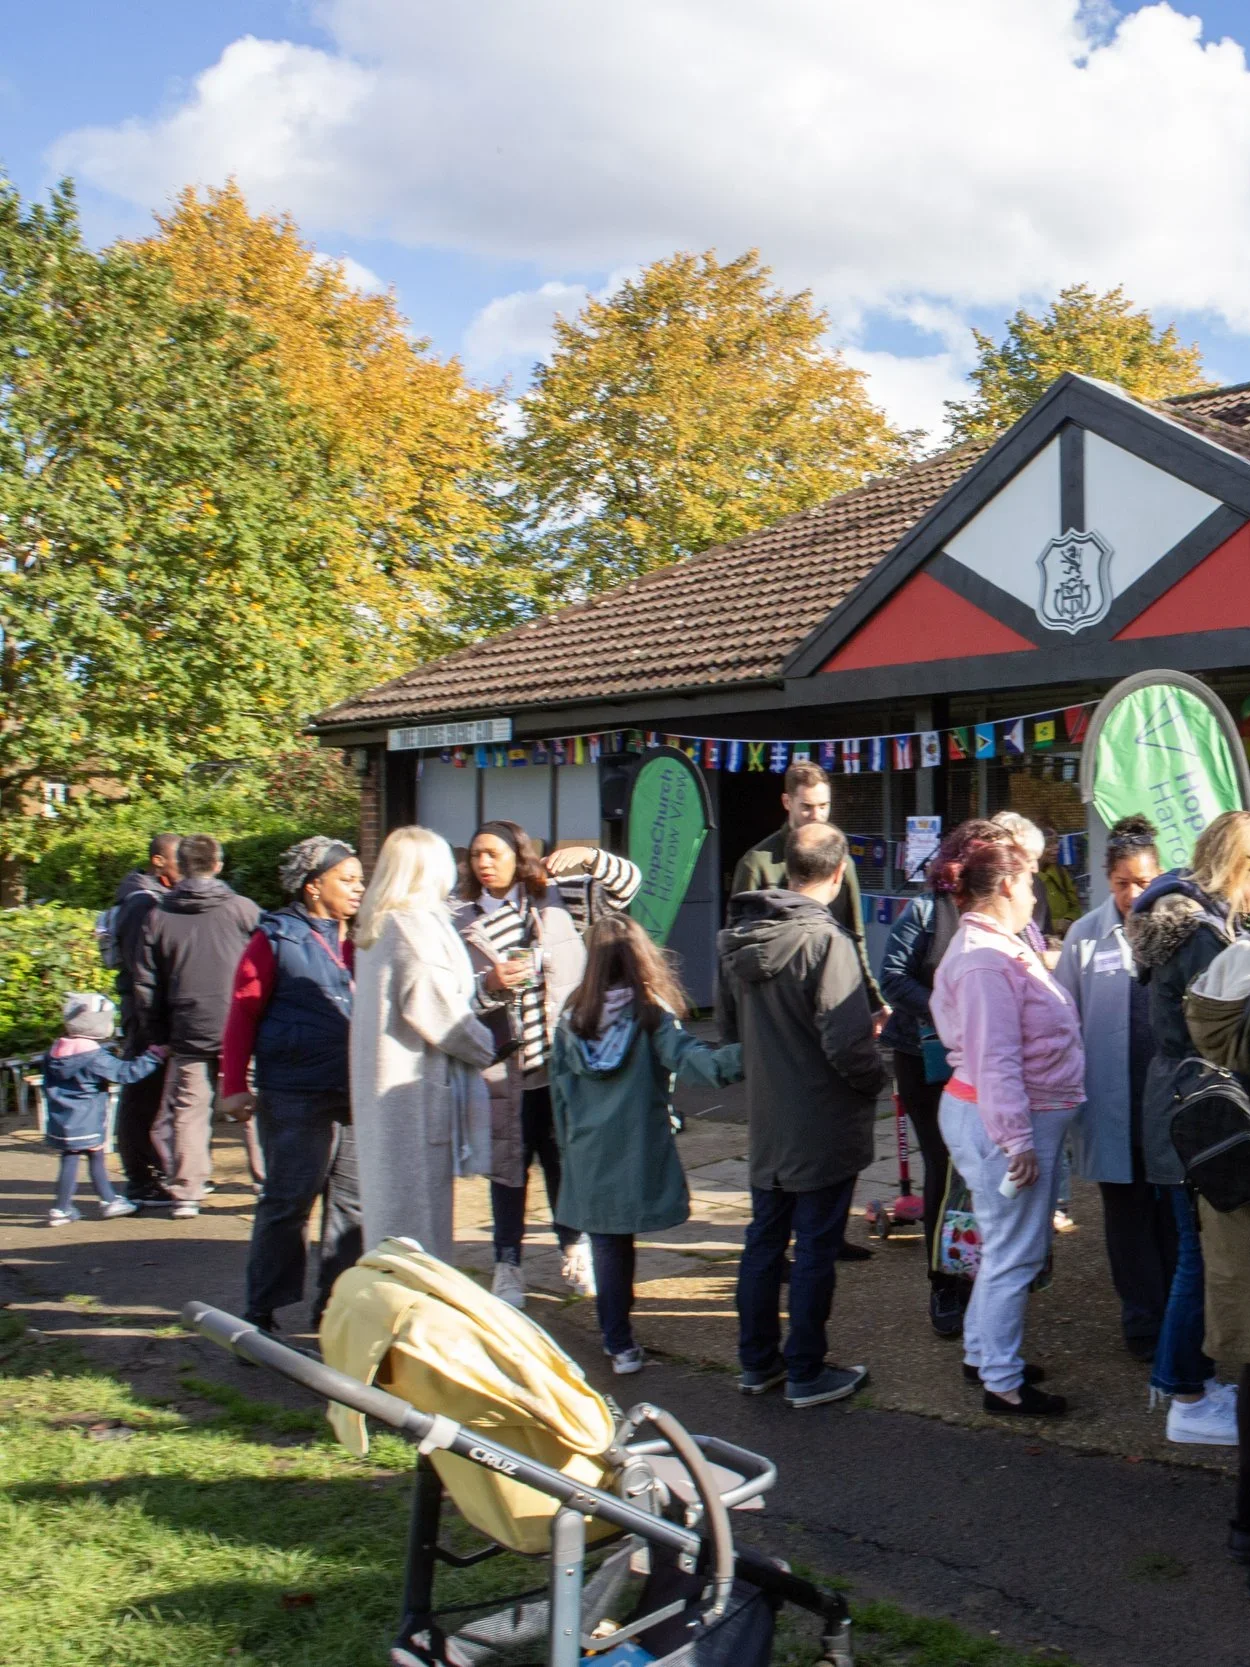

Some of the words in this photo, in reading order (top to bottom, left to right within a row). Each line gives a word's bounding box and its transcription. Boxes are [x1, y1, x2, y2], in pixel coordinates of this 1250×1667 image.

[643, 768, 673, 896] HopeChurch
[658, 828, 680, 902] Harrow
[669, 771, 689, 819] View
[1148, 781, 1188, 865] Harro
[1175, 770, 1207, 838] Hop
[468, 1447, 520, 1475] CRUZ
